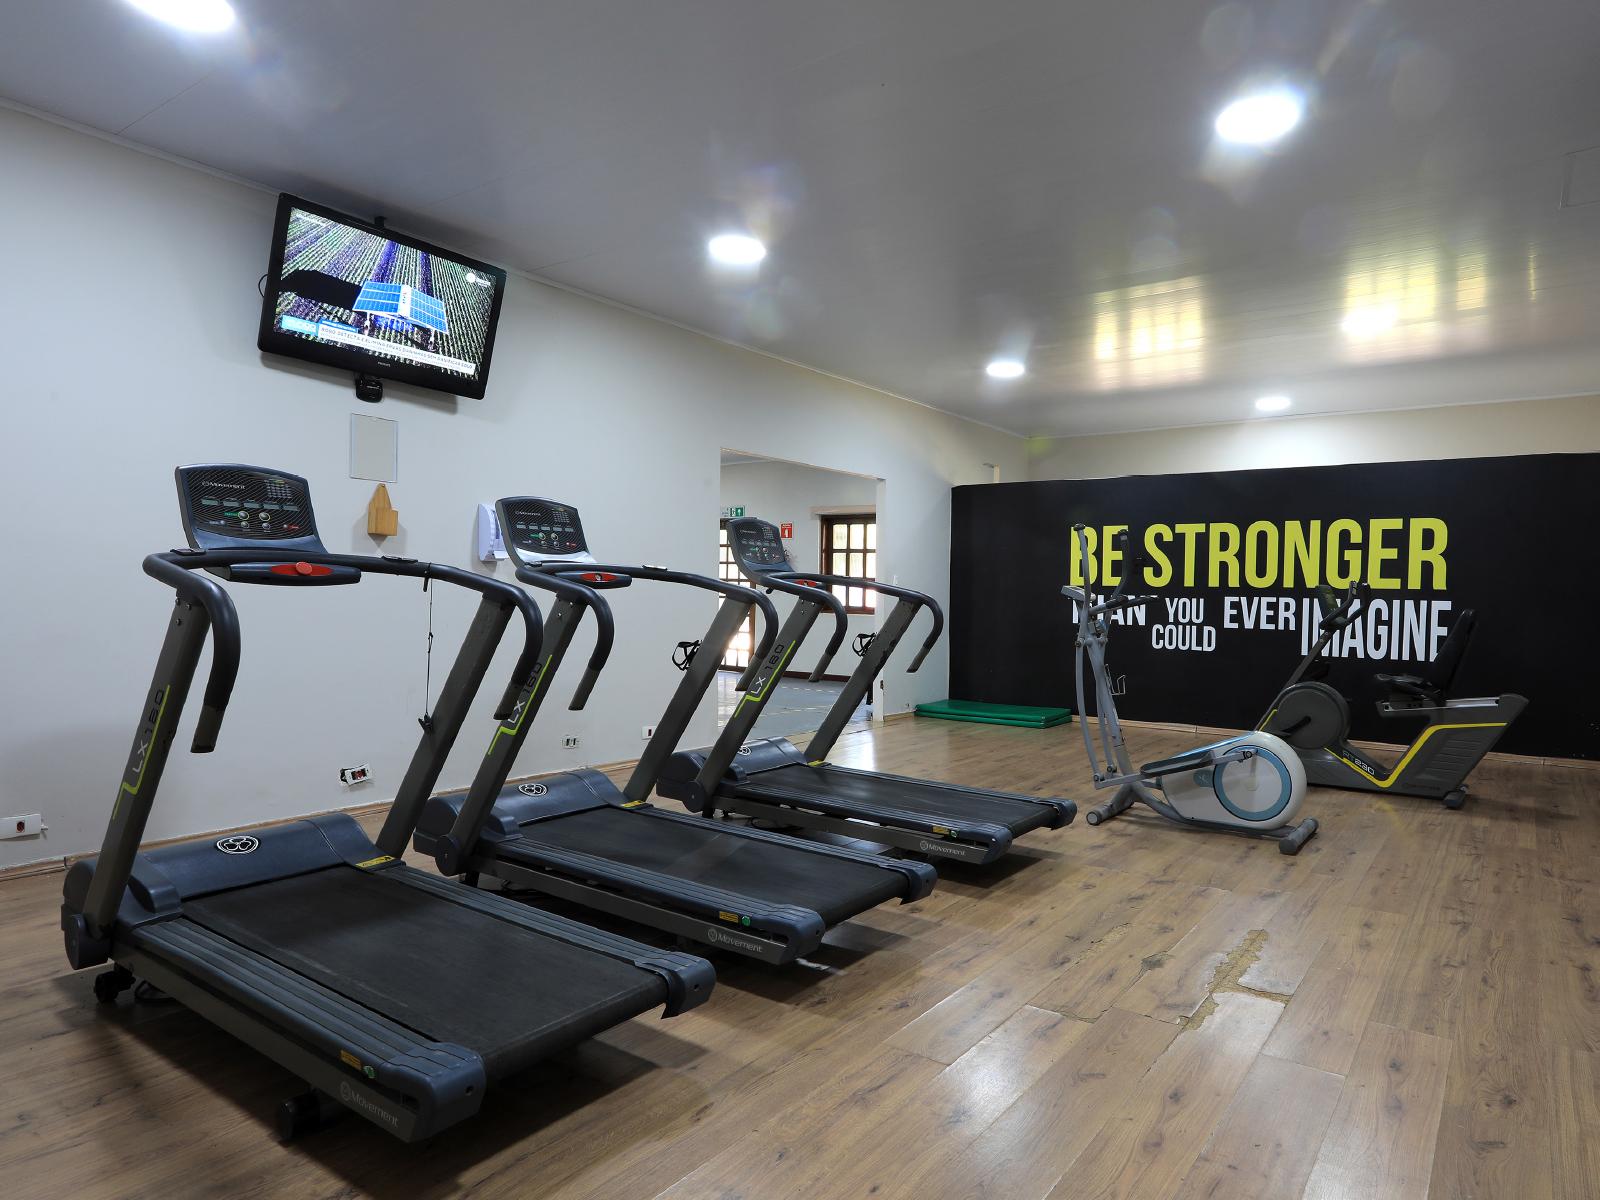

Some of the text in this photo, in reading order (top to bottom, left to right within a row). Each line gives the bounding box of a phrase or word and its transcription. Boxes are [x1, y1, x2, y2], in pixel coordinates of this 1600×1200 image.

[1070, 518, 1449, 591] BE STRONGER
[1165, 597, 1205, 624] YOU
[1223, 596, 1296, 631] EVER
[1151, 623, 1217, 652] COULD
[750, 676, 767, 694] LX
[508, 700, 526, 724] LX
[132, 739, 149, 773] LX
[929, 843, 966, 856] Movement
[717, 932, 764, 953] Movement
[350, 1090, 399, 1128] Movement
